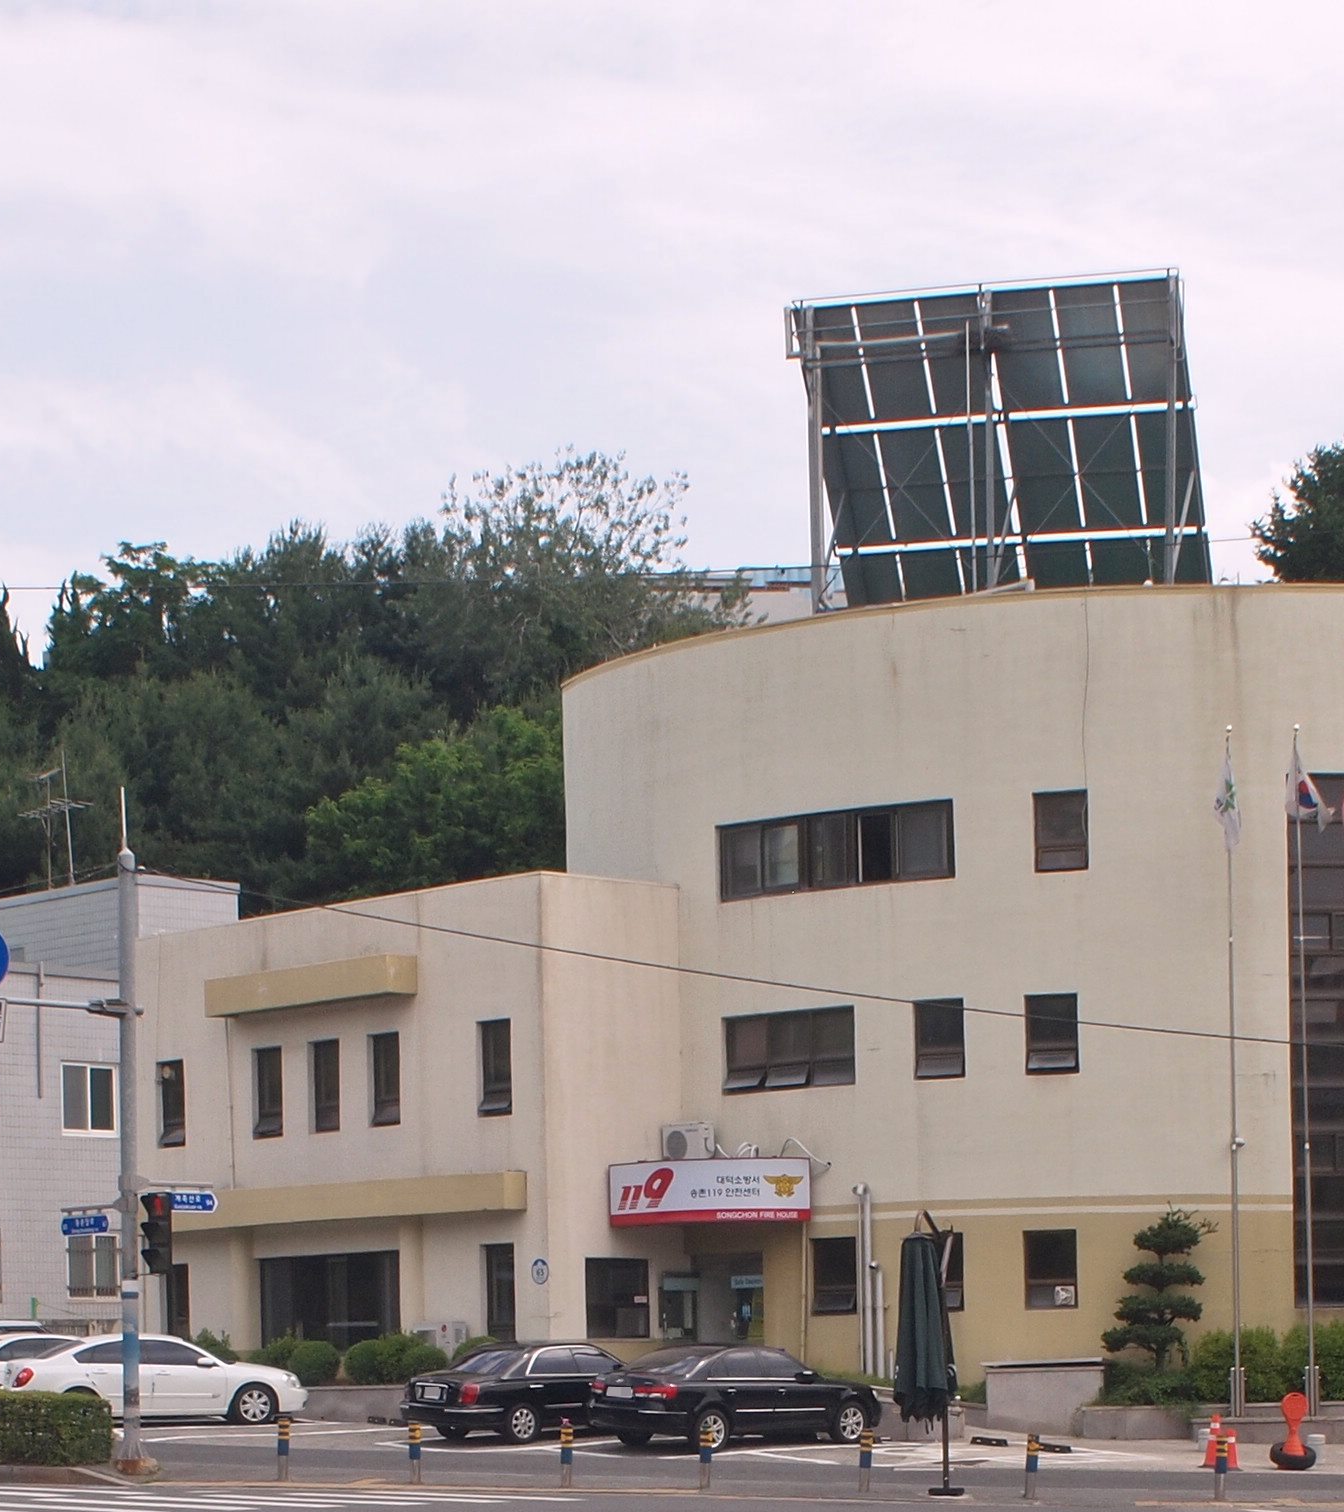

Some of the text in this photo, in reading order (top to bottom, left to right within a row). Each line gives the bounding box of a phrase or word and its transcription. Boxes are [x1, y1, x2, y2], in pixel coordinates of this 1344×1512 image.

[716, 1176, 760, 1185] 대덕소방서
[618, 1167, 675, 1211] 119
[725, 1188, 760, 1198] 안전센터
[716, 1211, 758, 1219] SONGCHON
